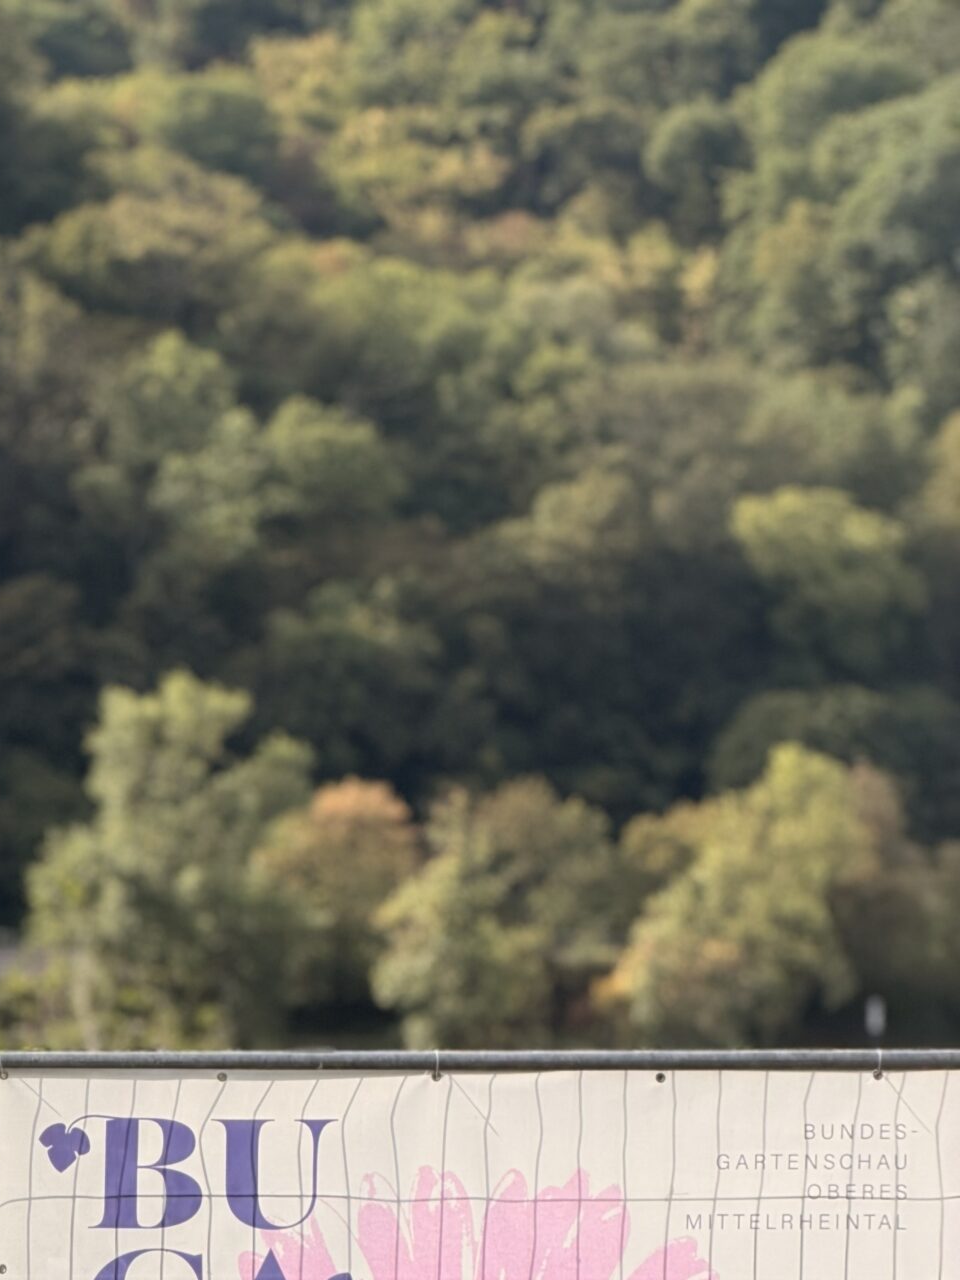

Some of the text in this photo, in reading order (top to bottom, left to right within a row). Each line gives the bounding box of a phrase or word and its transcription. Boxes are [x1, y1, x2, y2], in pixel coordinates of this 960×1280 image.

[804, 1124, 917, 1140] BUNDES-
[716, 1154, 908, 1170] GARTENSCHAU
[87, 1117, 339, 1230] BU
[807, 1184, 908, 1200] OBERES
[686, 1214, 908, 1230] MITTELRHEINTAL
